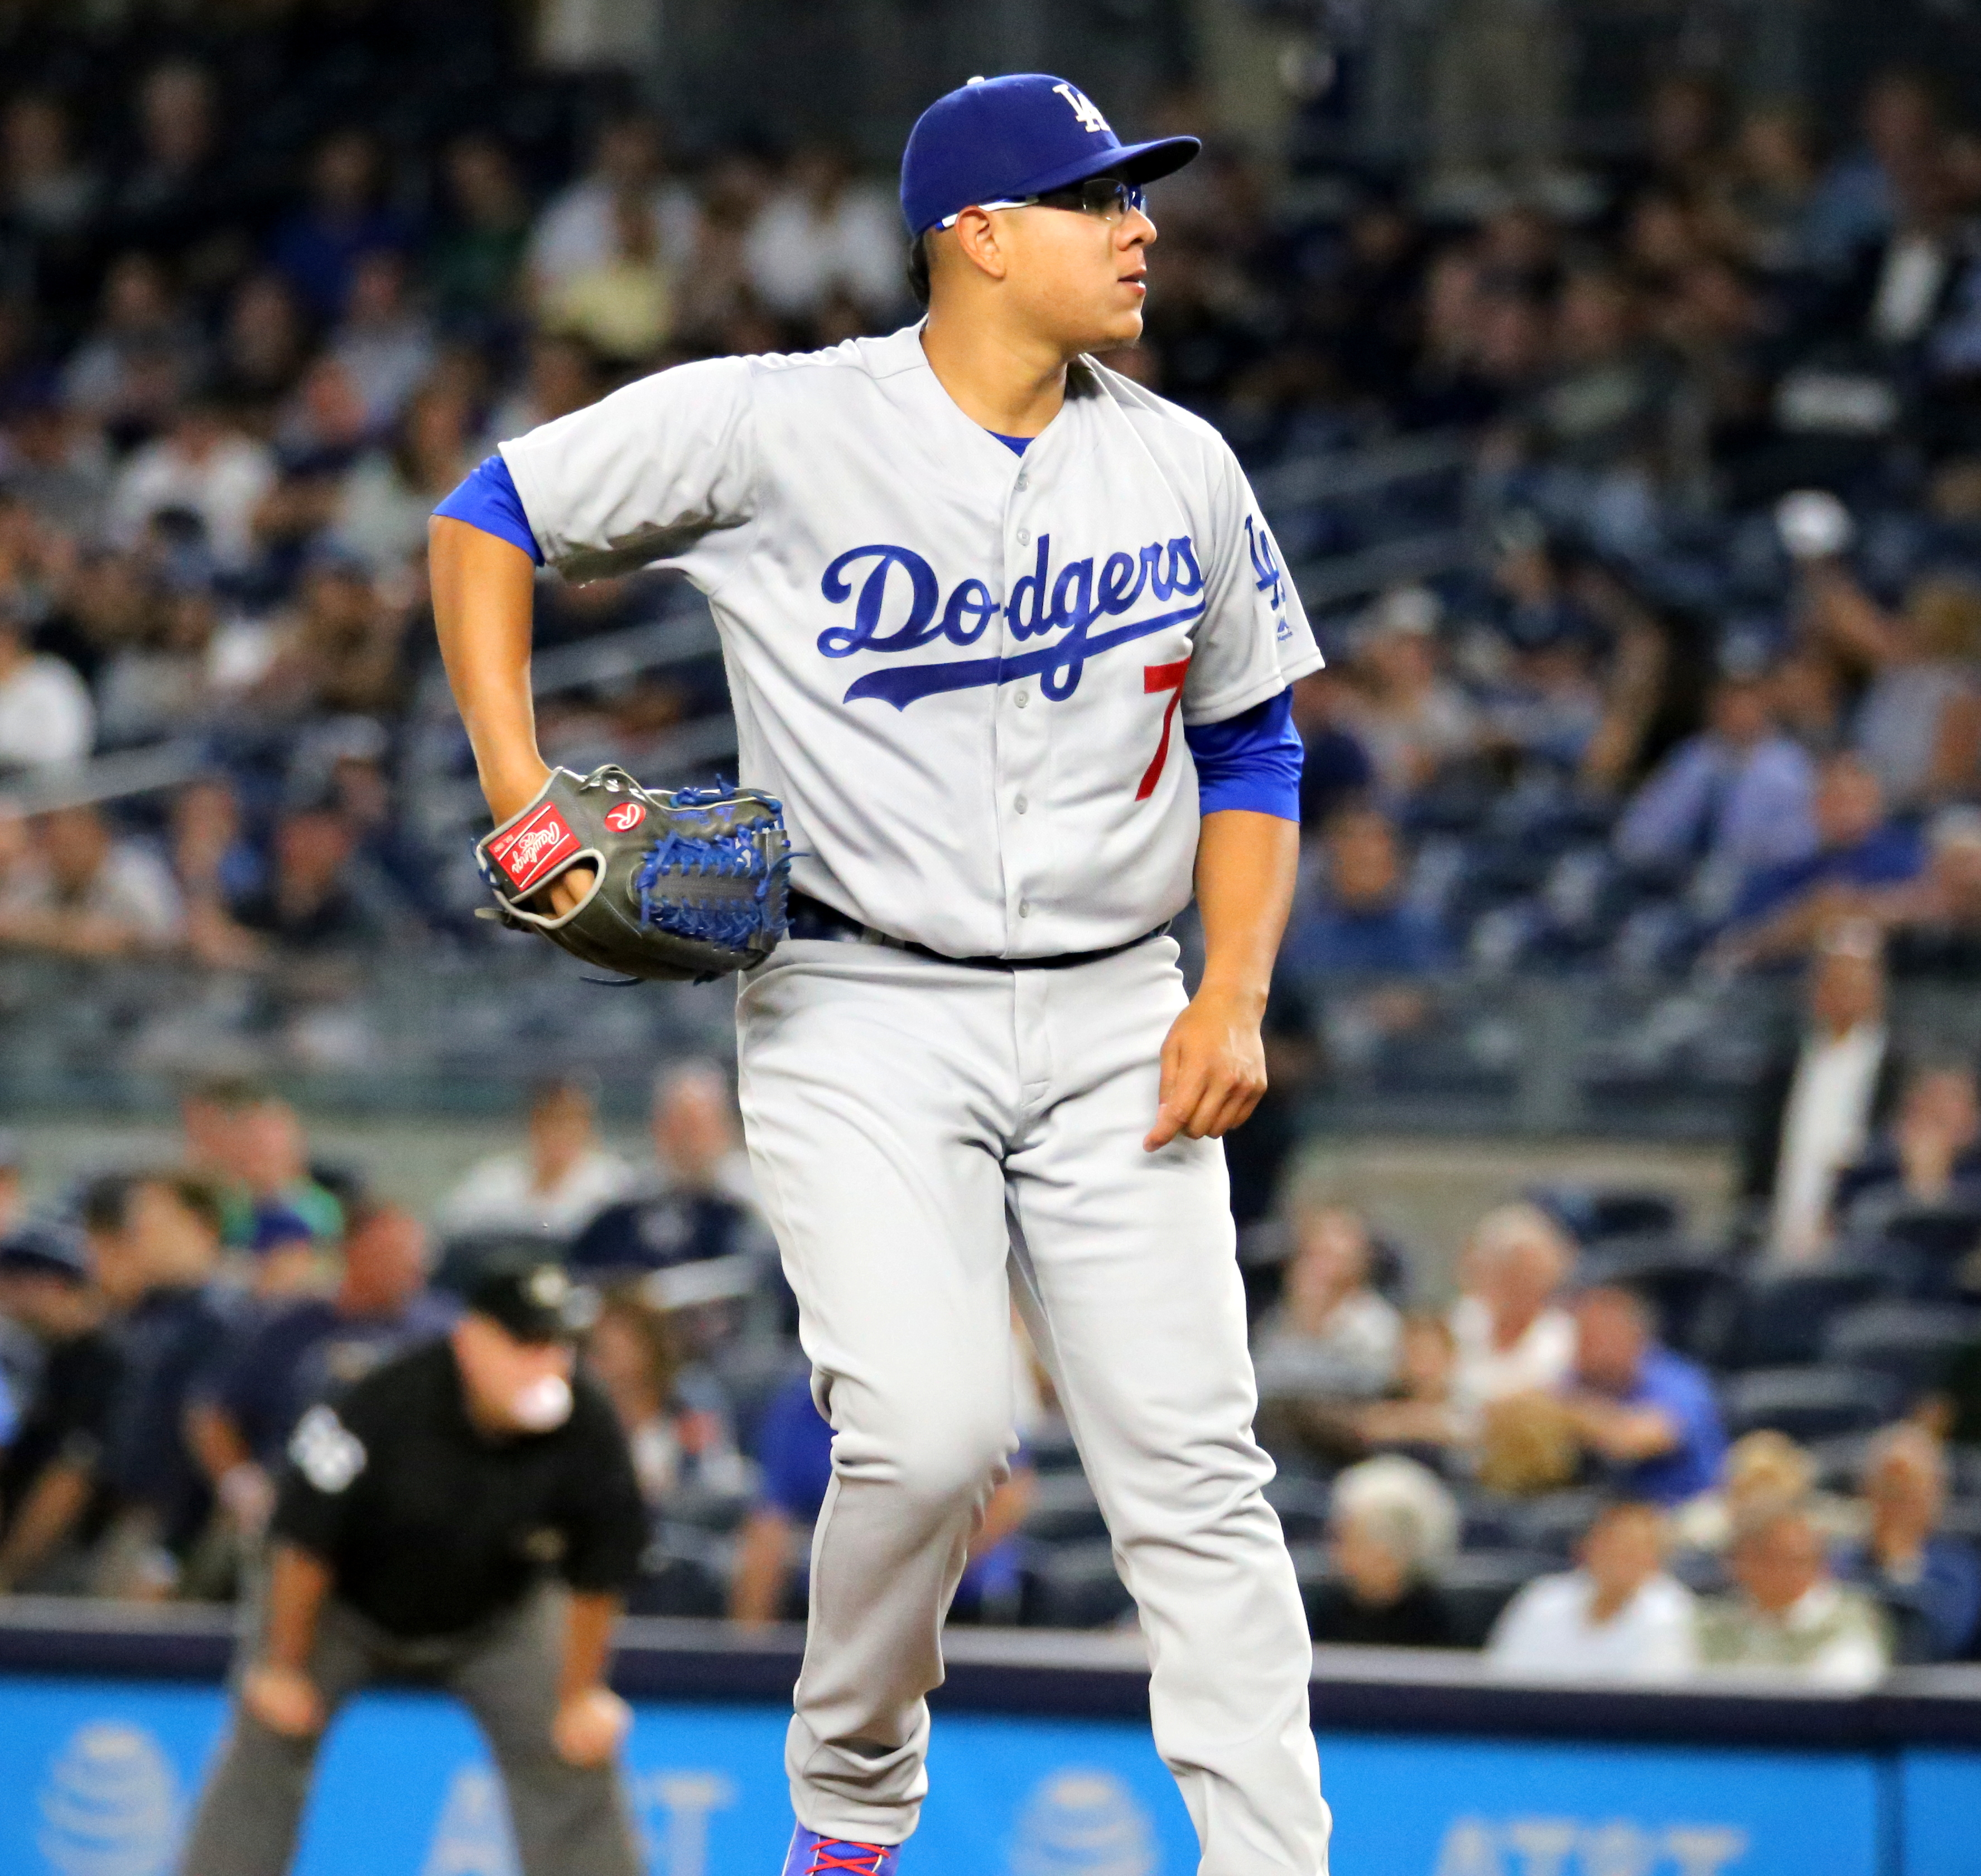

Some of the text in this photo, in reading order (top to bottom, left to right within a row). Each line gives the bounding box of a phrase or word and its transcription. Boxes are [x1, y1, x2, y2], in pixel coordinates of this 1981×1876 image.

[1053, 84, 1111, 133] LA
[817, 534, 1205, 702] Dodgers
[1135, 655, 1192, 802] 7
[511, 821, 560, 874] Rawlings
